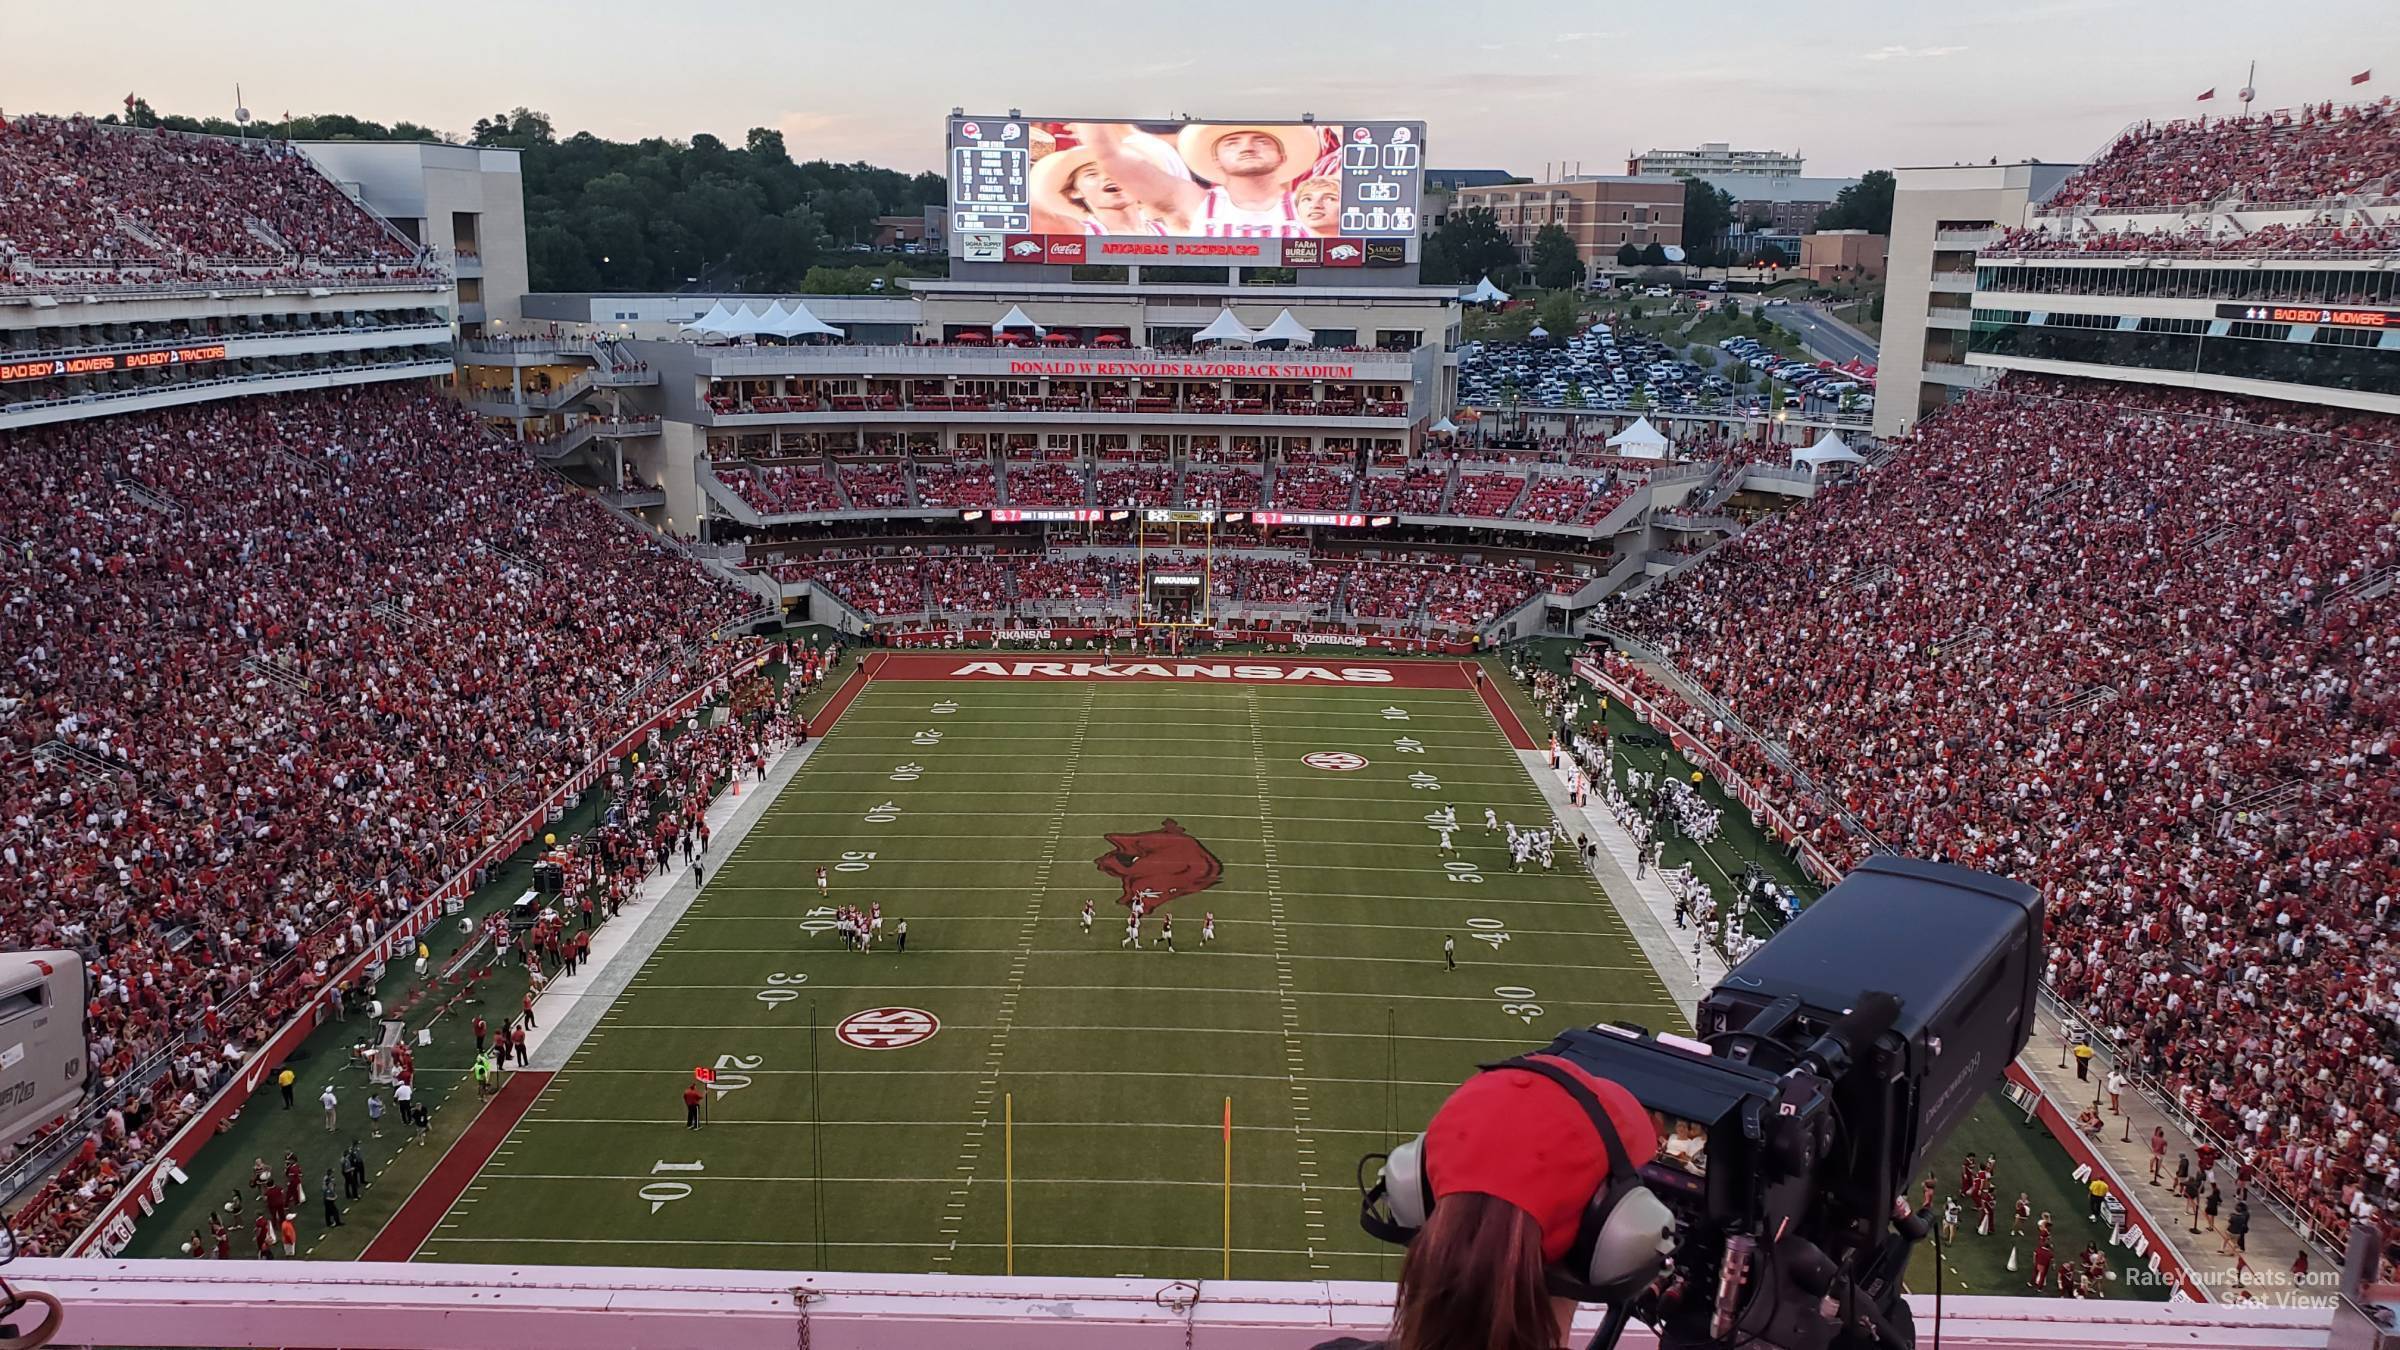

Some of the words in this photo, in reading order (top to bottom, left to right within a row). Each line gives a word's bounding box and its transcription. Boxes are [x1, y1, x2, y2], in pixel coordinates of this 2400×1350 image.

[1357, 147, 1366, 166] 7
[1394, 147, 1408, 166] 17
[1102, 244, 1168, 254] ARKANSAS
[1176, 244, 1260, 256] RAZORBACKS
[1294, 240, 1316, 248] FARM
[1368, 244, 1402, 256] SARACEN
[2274, 309, 2296, 320] BAD
[2298, 310, 2320, 322] BOY
[2332, 312, 2385, 325] MOWERS
[127, 354, 150, 366] BAD
[150, 352, 170, 364] BOY
[177, 346, 225, 362] TRACTORS
[1, 364, 28, 378] BAD
[29, 362, 54, 377] BOY
[66, 358, 114, 372] MOWERS
[1010, 362, 1076, 374] DONALD
[1080, 362, 1092, 374] W
[1098, 362, 1180, 376] REYNOLDS
[1184, 364, 1279, 377] RAZORBACK
[1283, 365, 1354, 378] STADIUM
[1154, 576, 1200, 584] ARKANSAS
[950, 661, 1394, 683] ARKANSAS
[930, 702, 960, 714] 10
[1380, 709, 1410, 721] 10
[912, 730, 943, 745] 20
[1392, 739, 1426, 754] 20
[890, 764, 924, 781] 30
[1407, 774, 1442, 790] 30
[864, 804, 902, 823] 40
[834, 850, 877, 872] 50
[1443, 862, 1484, 884] 50
[1466, 918, 1512, 944] 40
[756, 972, 808, 1002] 30
[1494, 986, 1546, 1017] 30
[707, 1054, 764, 1091] 20
[638, 1159, 705, 1201] 10
